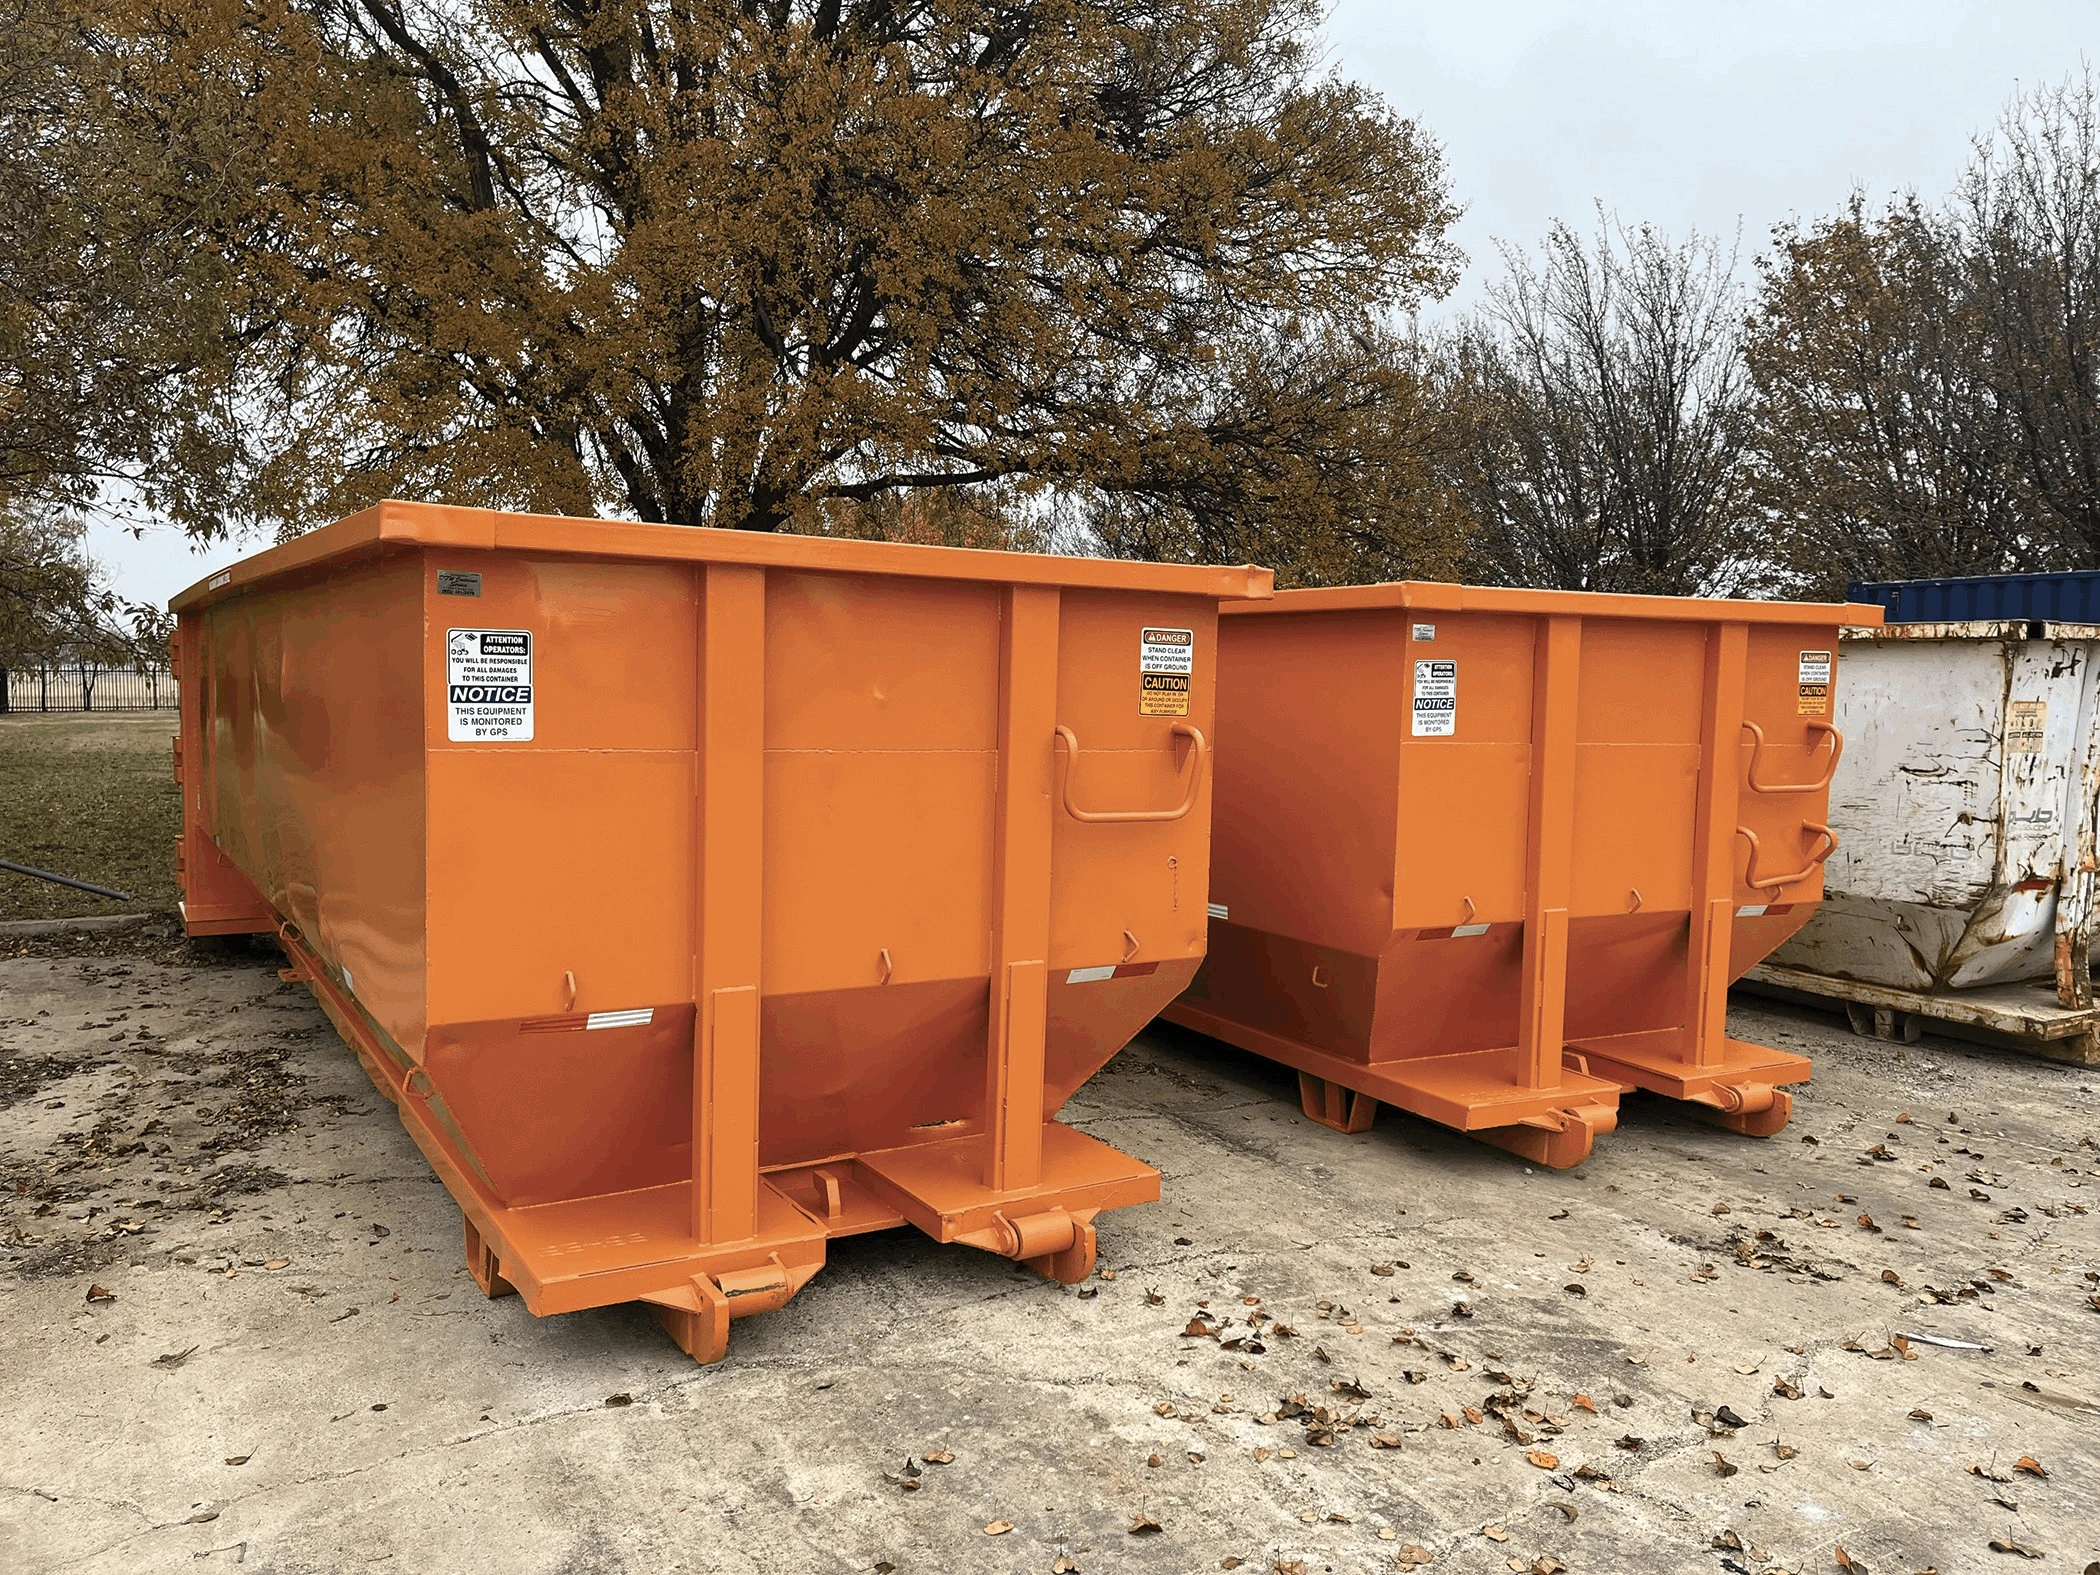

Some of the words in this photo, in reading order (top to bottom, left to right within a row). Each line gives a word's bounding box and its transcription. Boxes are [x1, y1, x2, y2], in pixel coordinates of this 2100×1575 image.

[486, 636, 523, 644] ATTENTION
[1156, 634, 1187, 642] DANGER
[484, 646, 526, 654] OPERATORS:
[1144, 677, 1187, 690] CAUTION
[452, 687, 530, 702] NOTICE
[1801, 687, 1826, 695] CAUTION
[1416, 699, 1454, 709] NOTICE
[477, 708, 526, 716] EQUIPMENT
